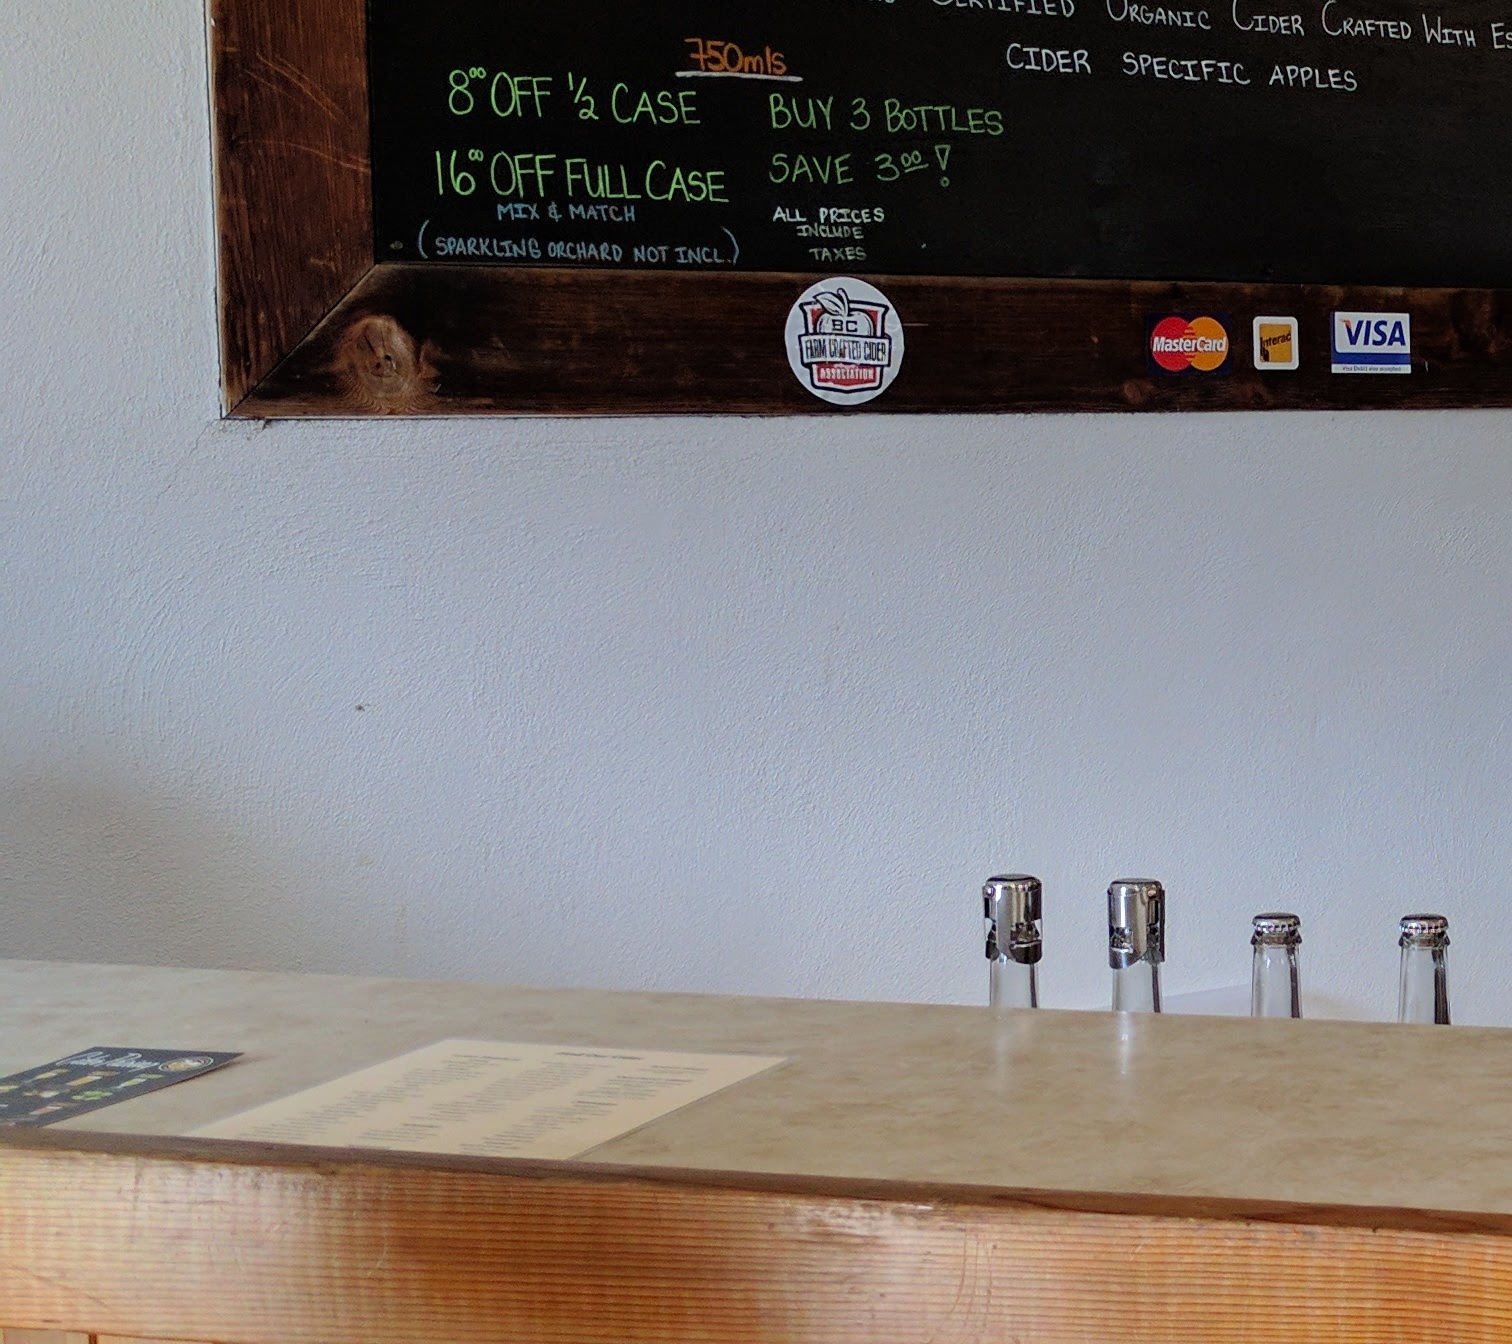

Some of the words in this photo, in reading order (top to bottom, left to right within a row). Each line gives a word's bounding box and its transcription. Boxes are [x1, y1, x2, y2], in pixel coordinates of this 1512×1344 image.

[1320, 0, 1412, 41] CRAFTED
[1421, 13, 1477, 49] WITH
[1005, 42, 1093, 75] CIDER
[1121, 51, 1252, 86] SPECIFIC
[1267, 64, 1359, 93] APPLES
[490, 71, 552, 117] OFF
[610, 80, 701, 125] CASE
[768, 93, 835, 131] BUY
[849, 96, 871, 131] 3
[884, 96, 1005, 137] BOTTLES
[490, 152, 557, 198] OFF
[565, 157, 642, 201] FULL
[645, 160, 730, 204] CASE
[768, 152, 854, 186] SAVE
[497, 202, 541, 223] MIX
[568, 203, 637, 224] MATCH
[773, 206, 809, 224] ALL
[818, 206, 885, 225] PRICES
[796, 223, 866, 240] INCLUDE
[547, 237, 623, 263] ORCHARD
[633, 242, 668, 263] NOT
[808, 245, 867, 262] TAXES
[831, 318, 858, 333] BC
[1341, 318, 1406, 347] VISA
[804, 338, 827, 360] FARM
[863, 340, 886, 362] CIDER
[1152, 335, 1227, 354] MasterCard
[1260, 329, 1292, 348] Interac
[819, 366, 875, 381] ASSOCIATION
